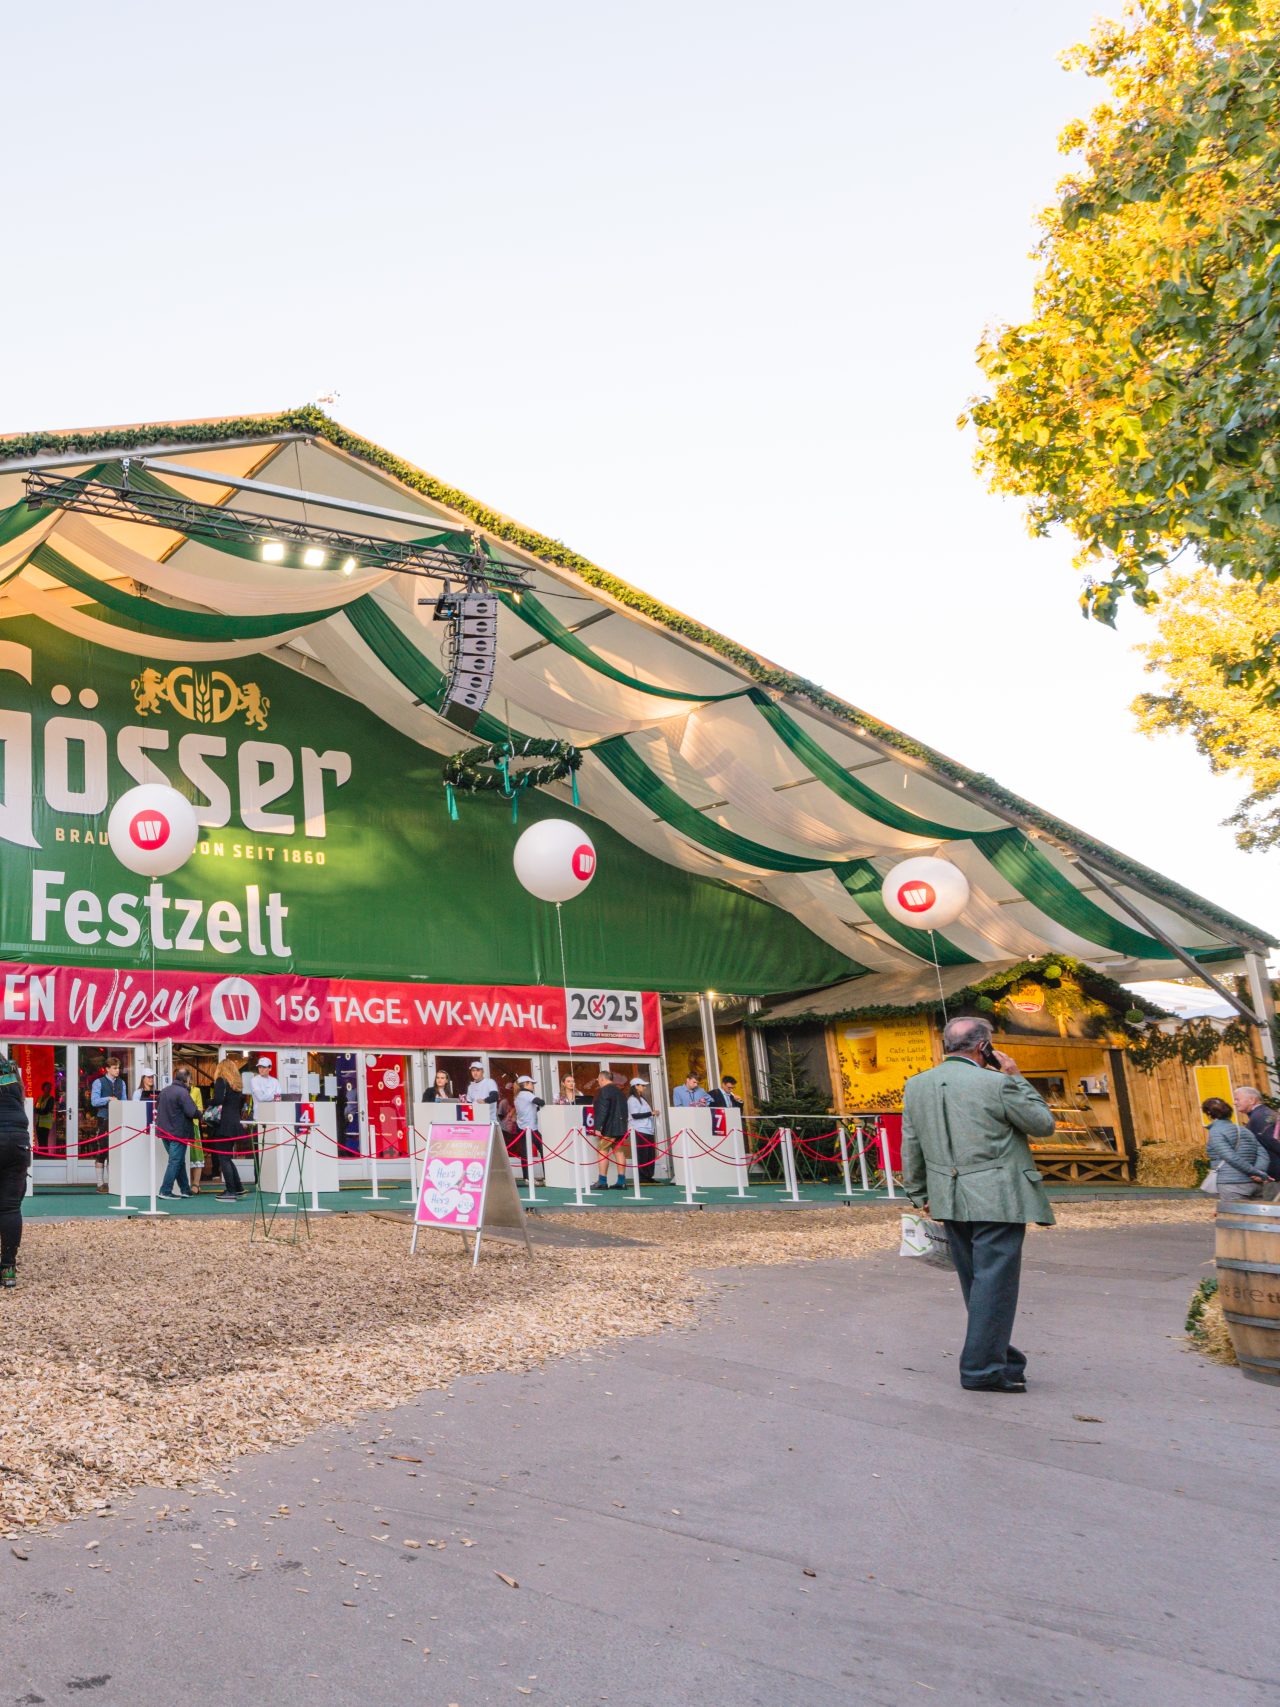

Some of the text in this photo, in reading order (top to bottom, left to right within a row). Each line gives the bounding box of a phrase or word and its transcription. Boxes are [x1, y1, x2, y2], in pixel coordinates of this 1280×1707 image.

[233, 846, 275, 861] SEIT
[282, 848, 326, 866] 1860
[31, 869, 292, 958] Festzelt
[69, 969, 198, 1032] Wiesn
[571, 993, 638, 1023] 2025
[275, 994, 557, 1031] 156 TAGE. WK-WAHL.
[299, 1110, 311, 1124] 4
[586, 1113, 595, 1127] 6
[714, 1114, 723, 1128] 7
[1233, 1286, 1265, 1303] are
